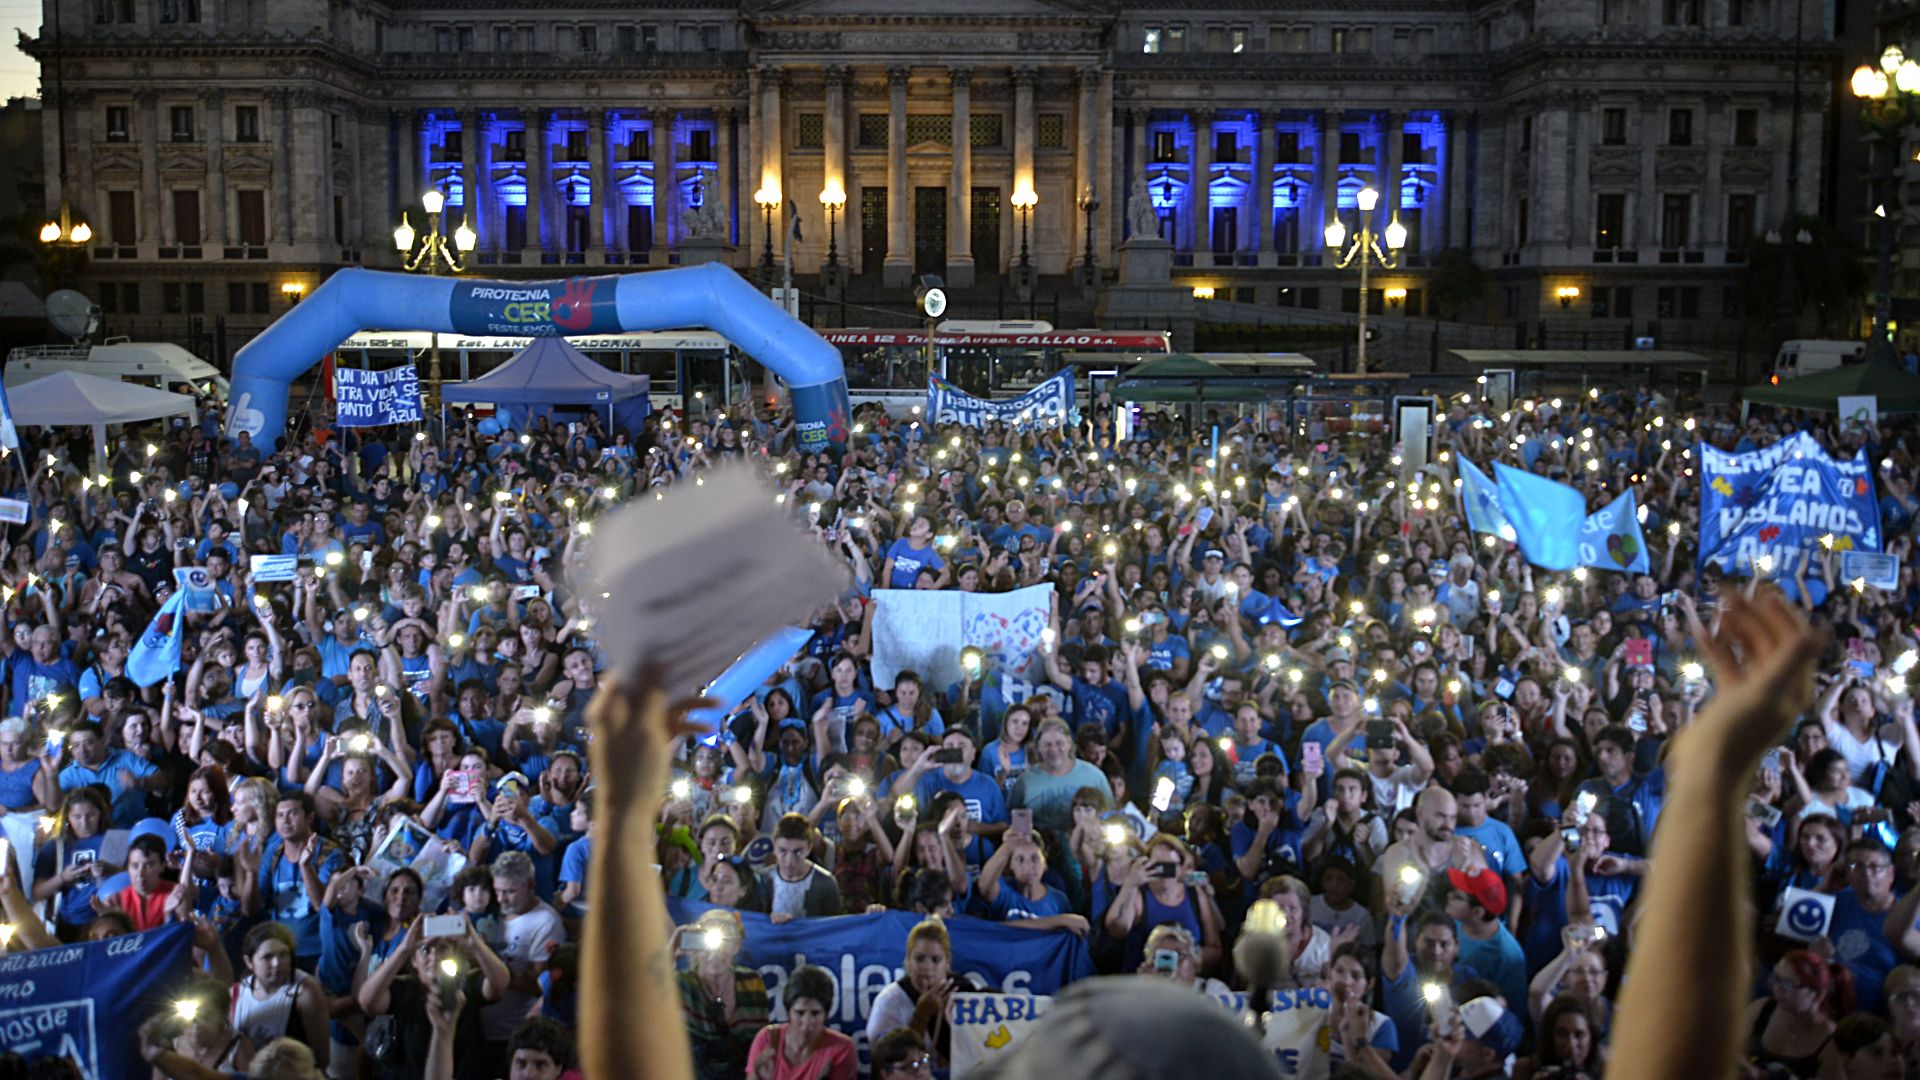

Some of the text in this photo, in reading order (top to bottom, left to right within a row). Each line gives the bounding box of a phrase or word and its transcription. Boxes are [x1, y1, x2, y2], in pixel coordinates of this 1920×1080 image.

[471, 287, 550, 300] PIROTECNIA
[493, 340, 535, 348] LANU
[823, 334, 868, 343] LINEA
[874, 334, 896, 343] 12
[1016, 335, 1091, 345] CALLAO
[338, 369, 355, 383] UN
[339, 383, 420, 401] TRA VIDA SE
[378, 398, 393, 413] DE
[388, 409, 421, 424] AZUL
